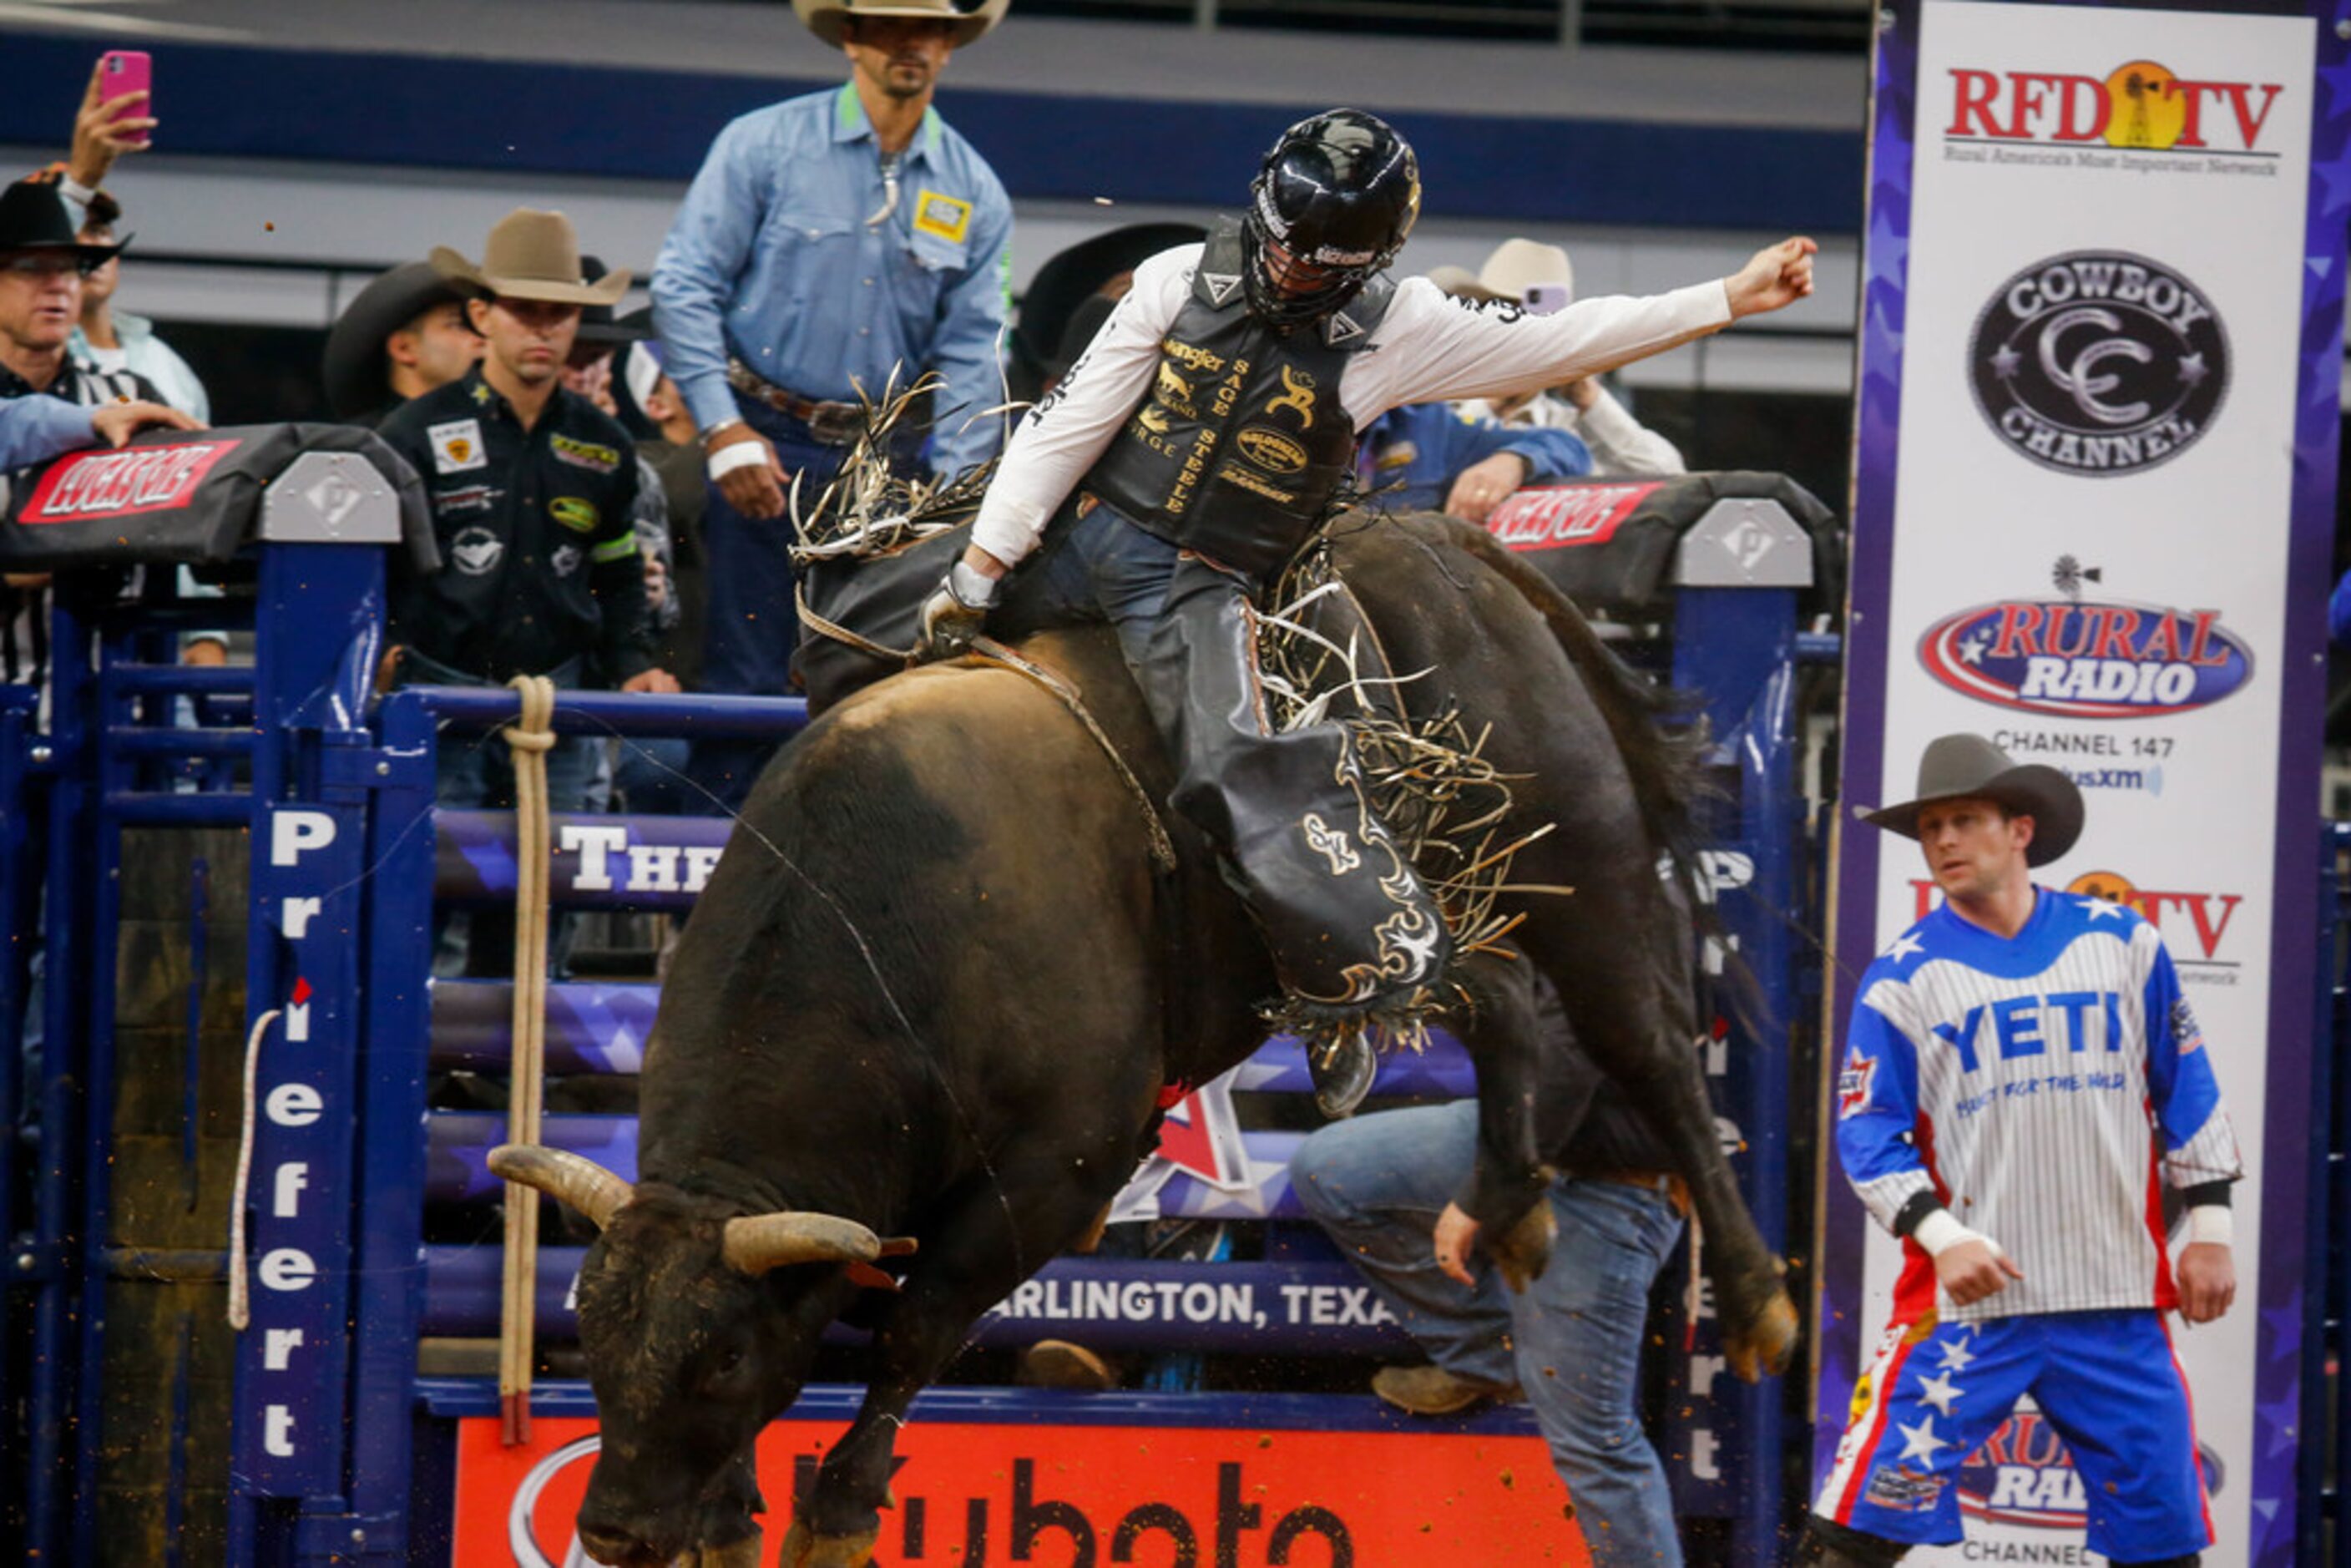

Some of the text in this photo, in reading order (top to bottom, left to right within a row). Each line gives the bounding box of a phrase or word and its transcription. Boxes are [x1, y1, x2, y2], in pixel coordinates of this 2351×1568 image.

[1945, 68, 2284, 150] RFD TV
[2007, 260, 2211, 332] COWBOY
[2002, 406, 2195, 468] CHANNEL
[1987, 604, 2230, 666] RURAL
[2020, 655, 2197, 705] RADIO
[1994, 731, 2175, 758] CHANNEL 147
[1932, 991, 2123, 1075] YETI
[258, 810, 336, 1457] Priefert
